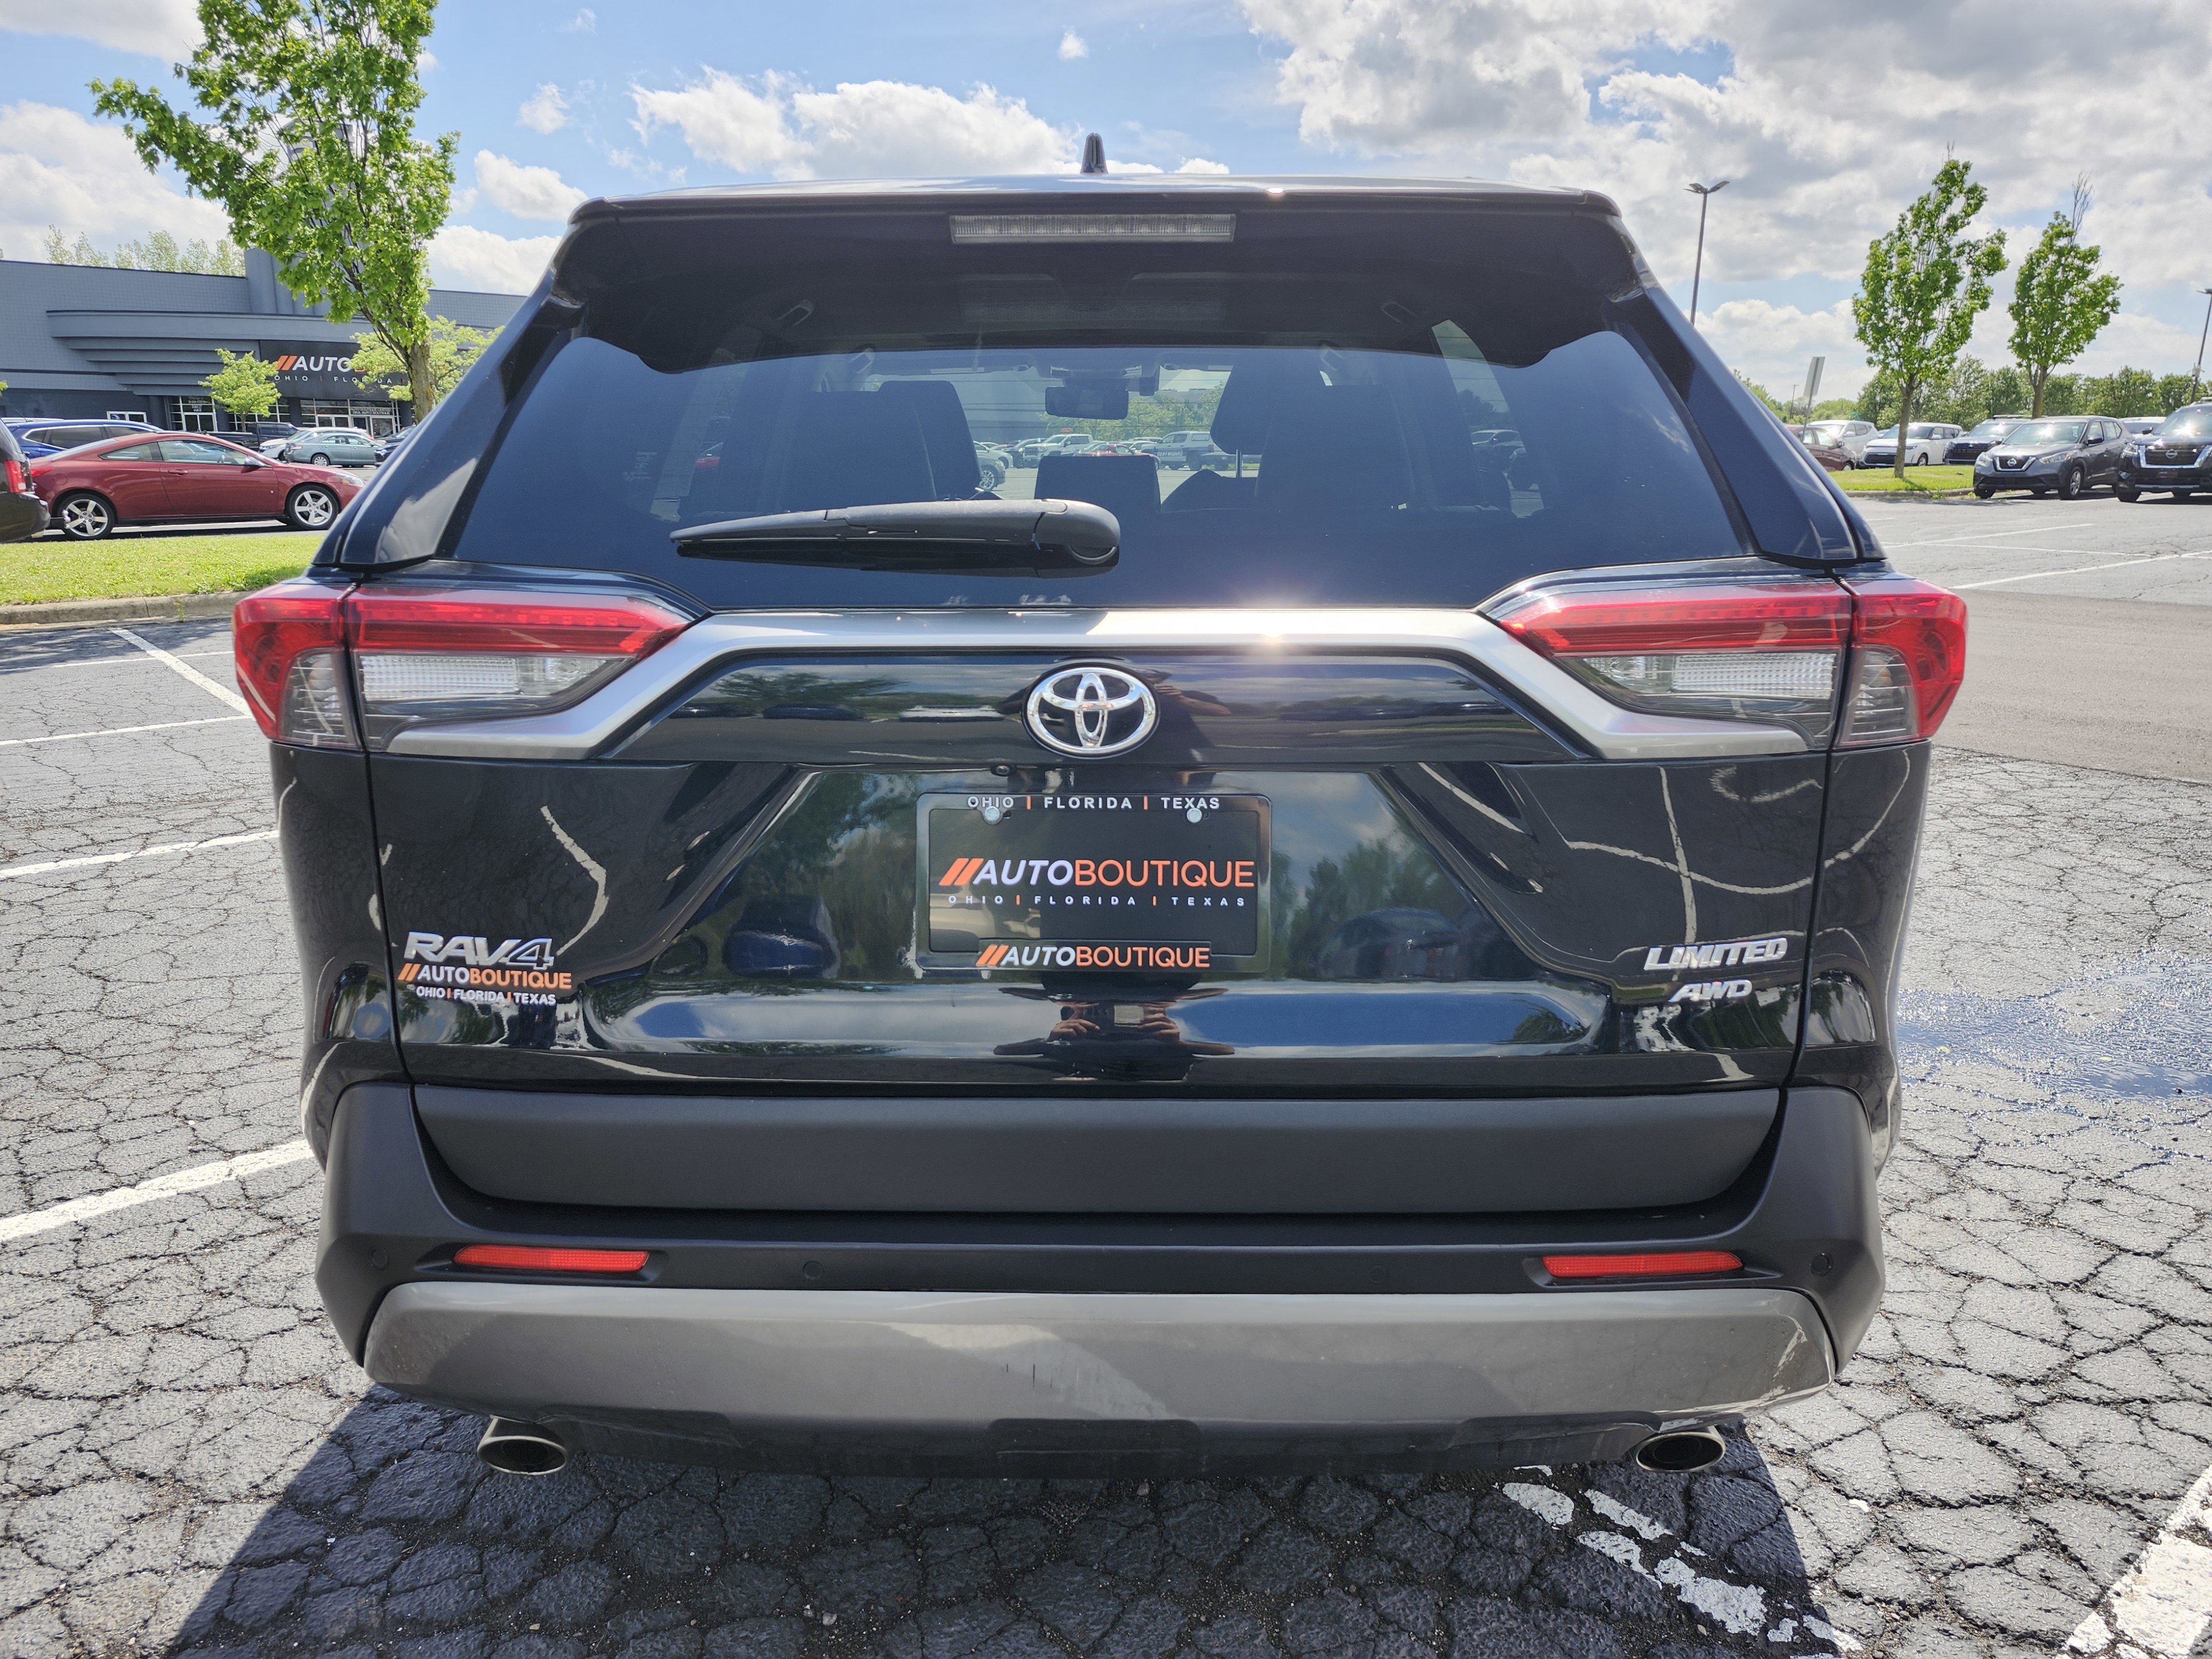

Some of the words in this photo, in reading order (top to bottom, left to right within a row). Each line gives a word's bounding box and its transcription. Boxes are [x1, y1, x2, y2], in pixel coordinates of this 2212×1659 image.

[967, 796, 1015, 808] OHIO
[1044, 796, 1133, 810] FLORIDA
[1161, 797, 1220, 810] TEXAS
[948, 895, 1004, 905] OHIO
[1034, 895, 1136, 906] FLORIDA
[1171, 896, 1245, 907] TEXAS
[404, 931, 554, 971] RAV4
[1644, 937, 1788, 971] LIMITED
[416, 986, 446, 999] OHIO
[453, 989, 504, 1002] FLORIDA
[513, 992, 556, 1006] TEXAS
[1668, 979, 1752, 1003] AWD
